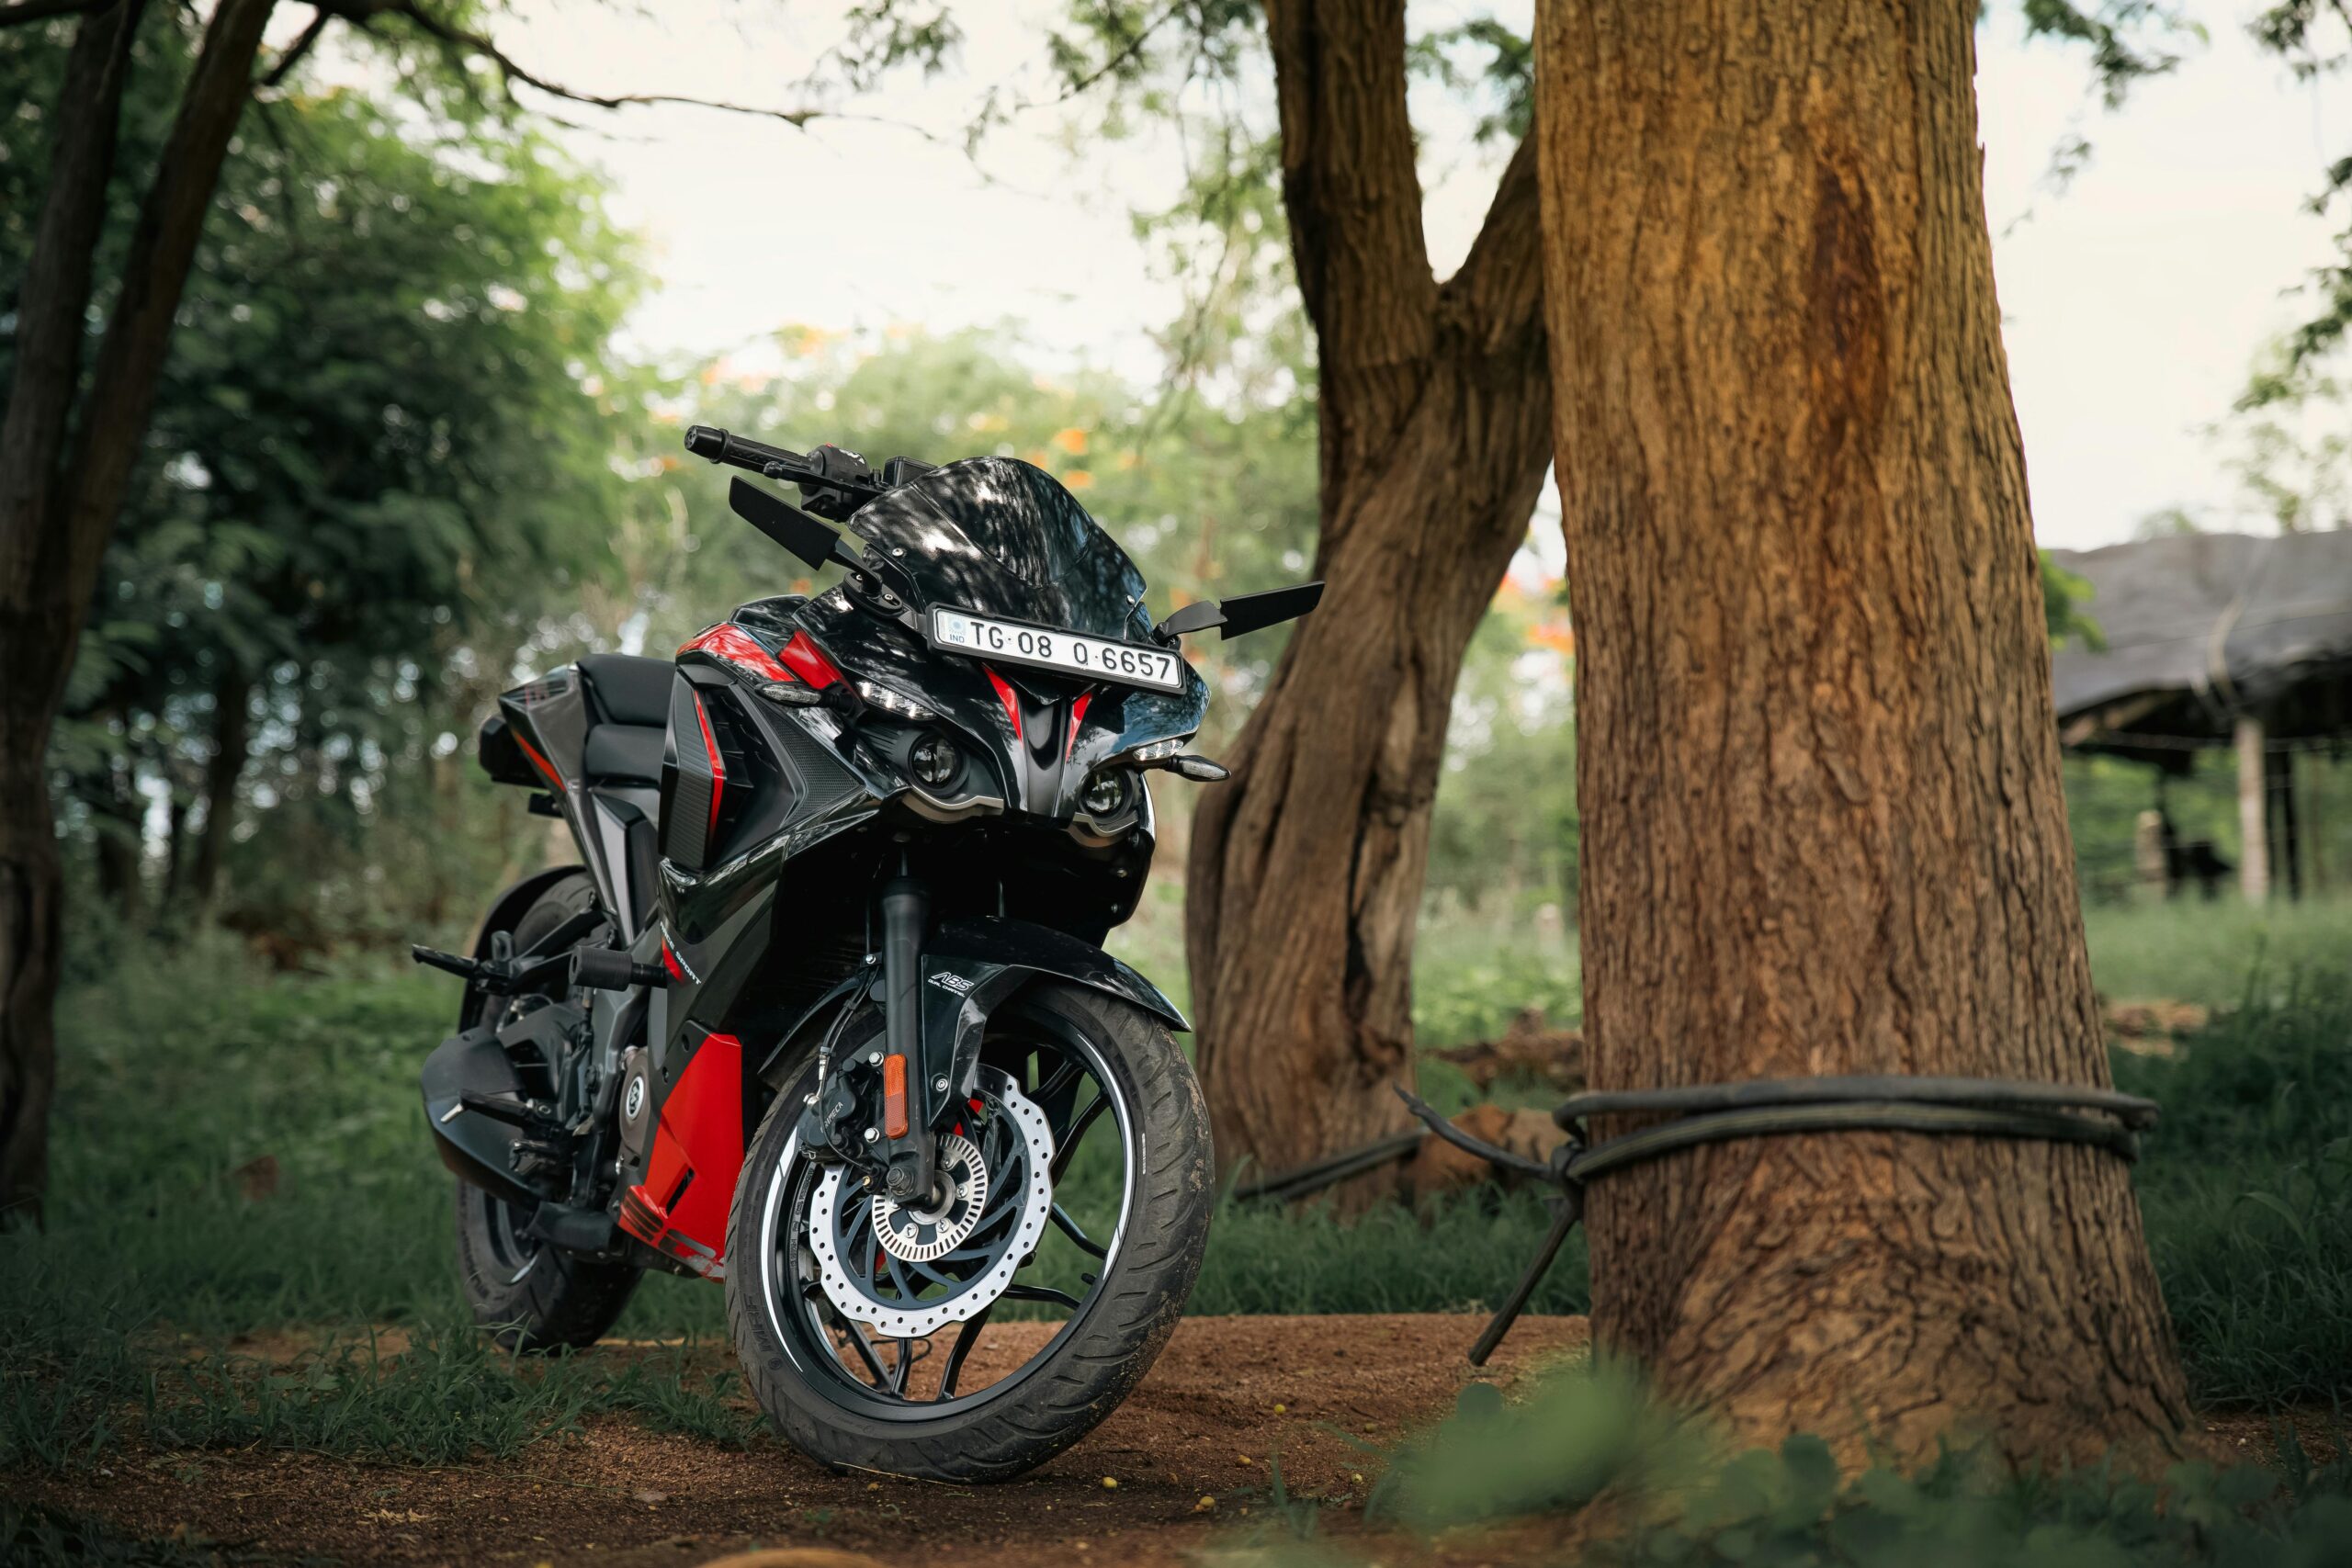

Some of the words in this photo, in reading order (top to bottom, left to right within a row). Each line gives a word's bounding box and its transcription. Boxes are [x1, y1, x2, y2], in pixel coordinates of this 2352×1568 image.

[949, 634, 966, 644] IND
[969, 621, 1004, 649] TG
[1017, 631, 1053, 658] 08
[1102, 648, 1171, 680] 6657
[675, 951, 701, 985] SPORT
[930, 971, 975, 991] ABS
